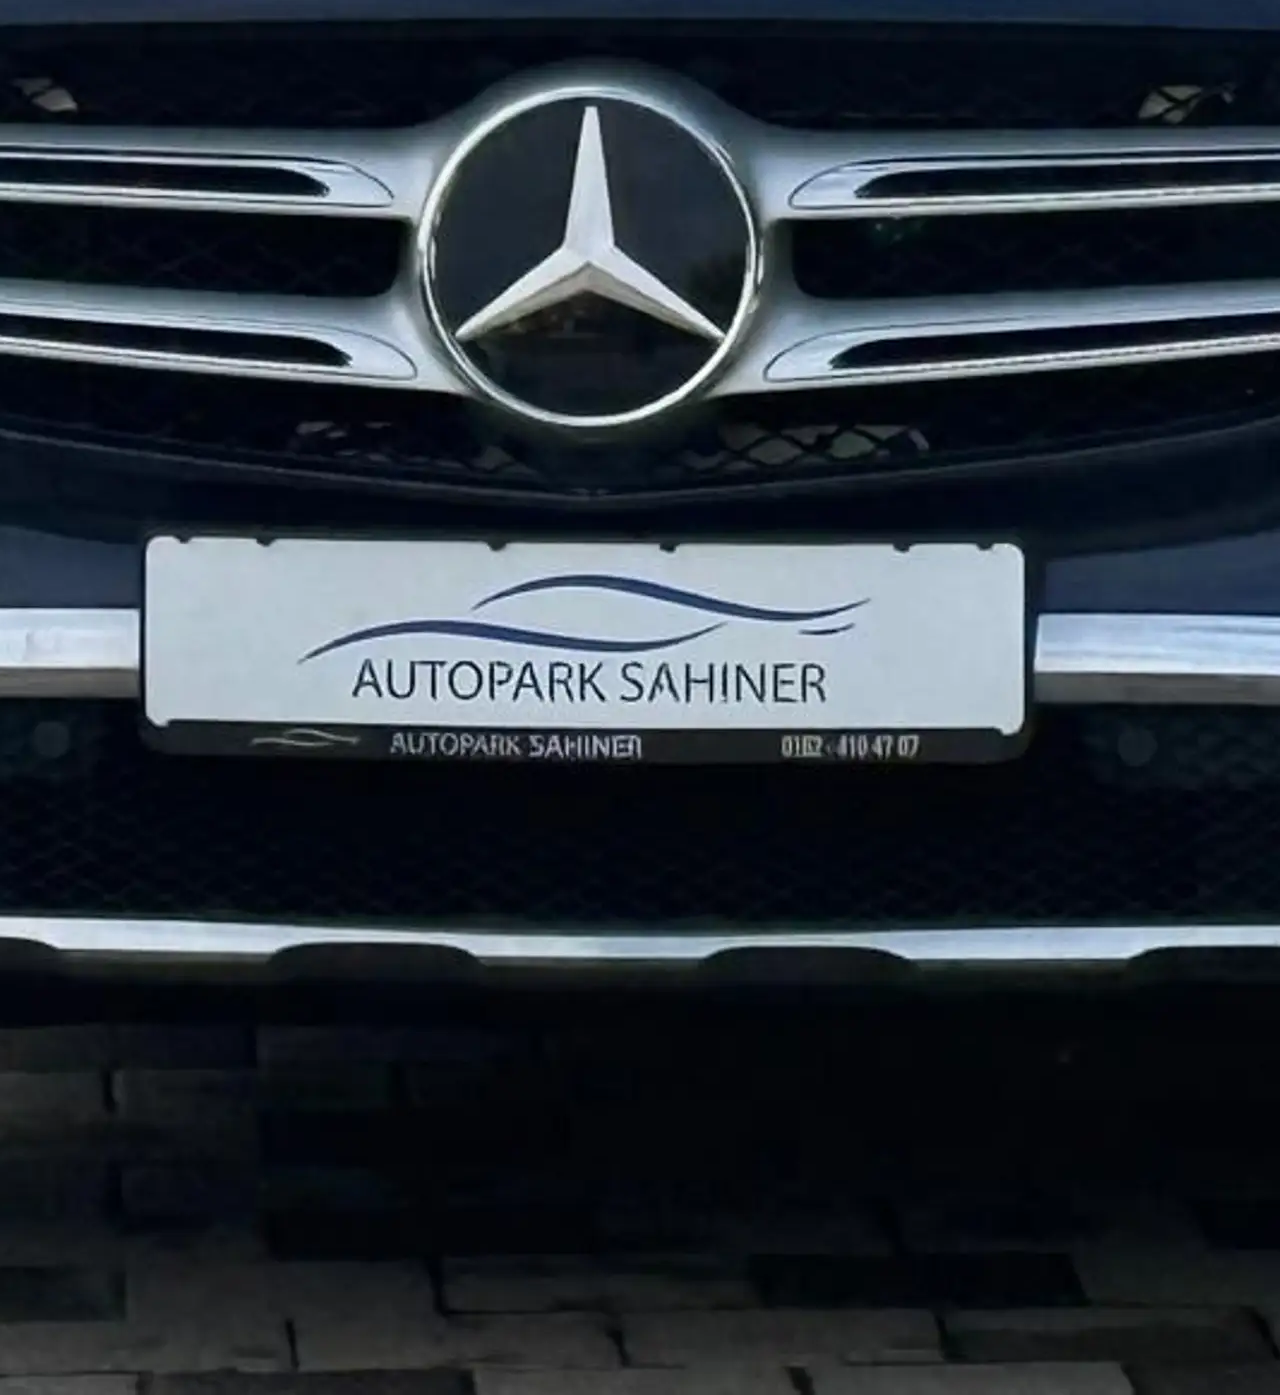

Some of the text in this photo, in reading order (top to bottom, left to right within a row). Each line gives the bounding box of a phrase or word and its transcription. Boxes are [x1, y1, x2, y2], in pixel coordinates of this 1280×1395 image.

[351, 657, 828, 704] AUTOPARK SAHINER
[389, 731, 643, 759] AUTOPARK SAHINER
